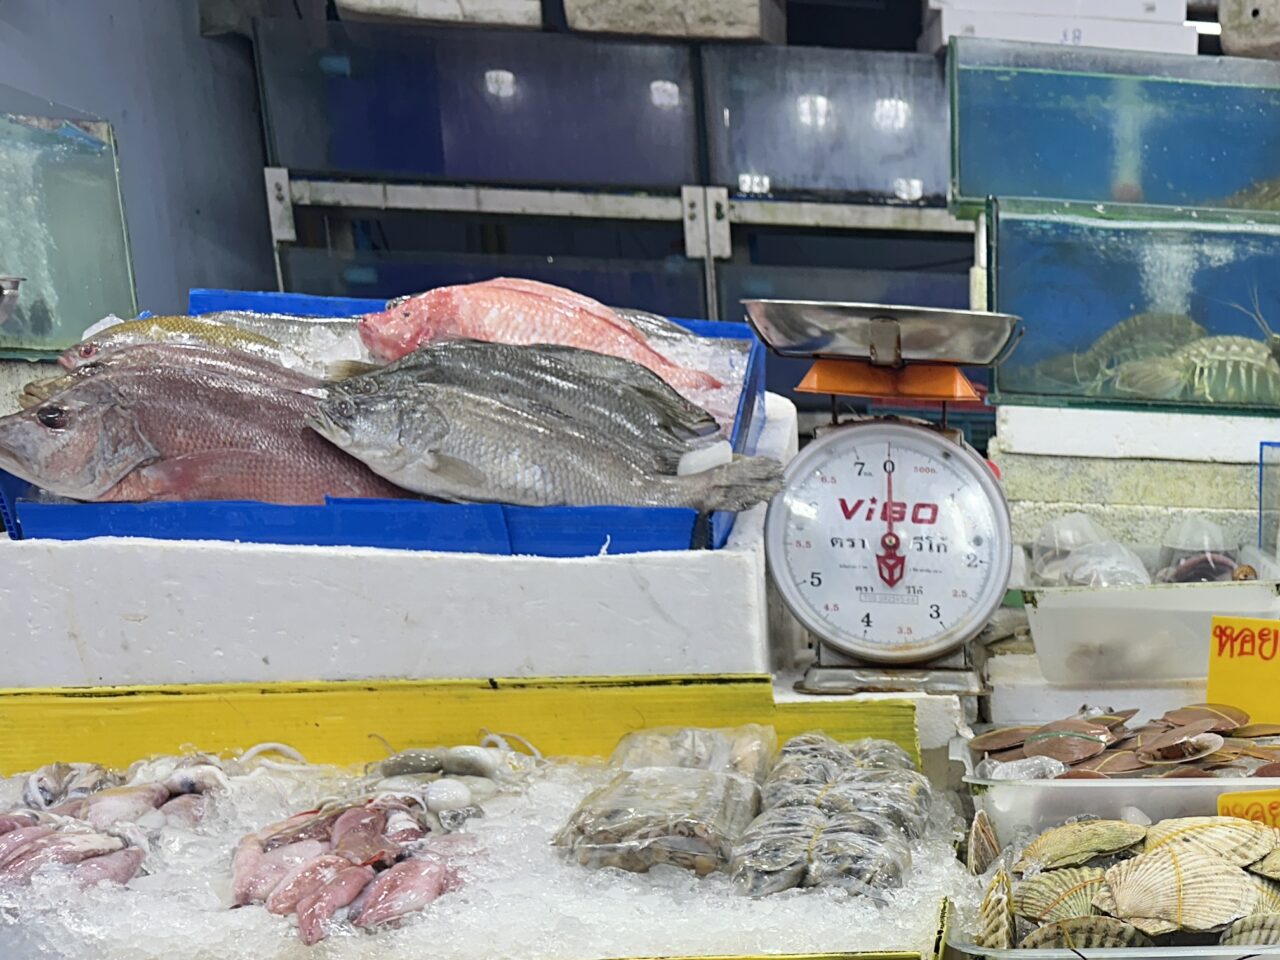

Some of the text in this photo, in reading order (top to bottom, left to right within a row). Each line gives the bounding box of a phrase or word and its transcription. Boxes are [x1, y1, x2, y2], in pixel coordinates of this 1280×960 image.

[830, 535, 948, 554] ตรา วีโก้
[810, 572, 822, 587] 5
[929, 604, 941, 619] 3
[860, 613, 873, 627] 4
